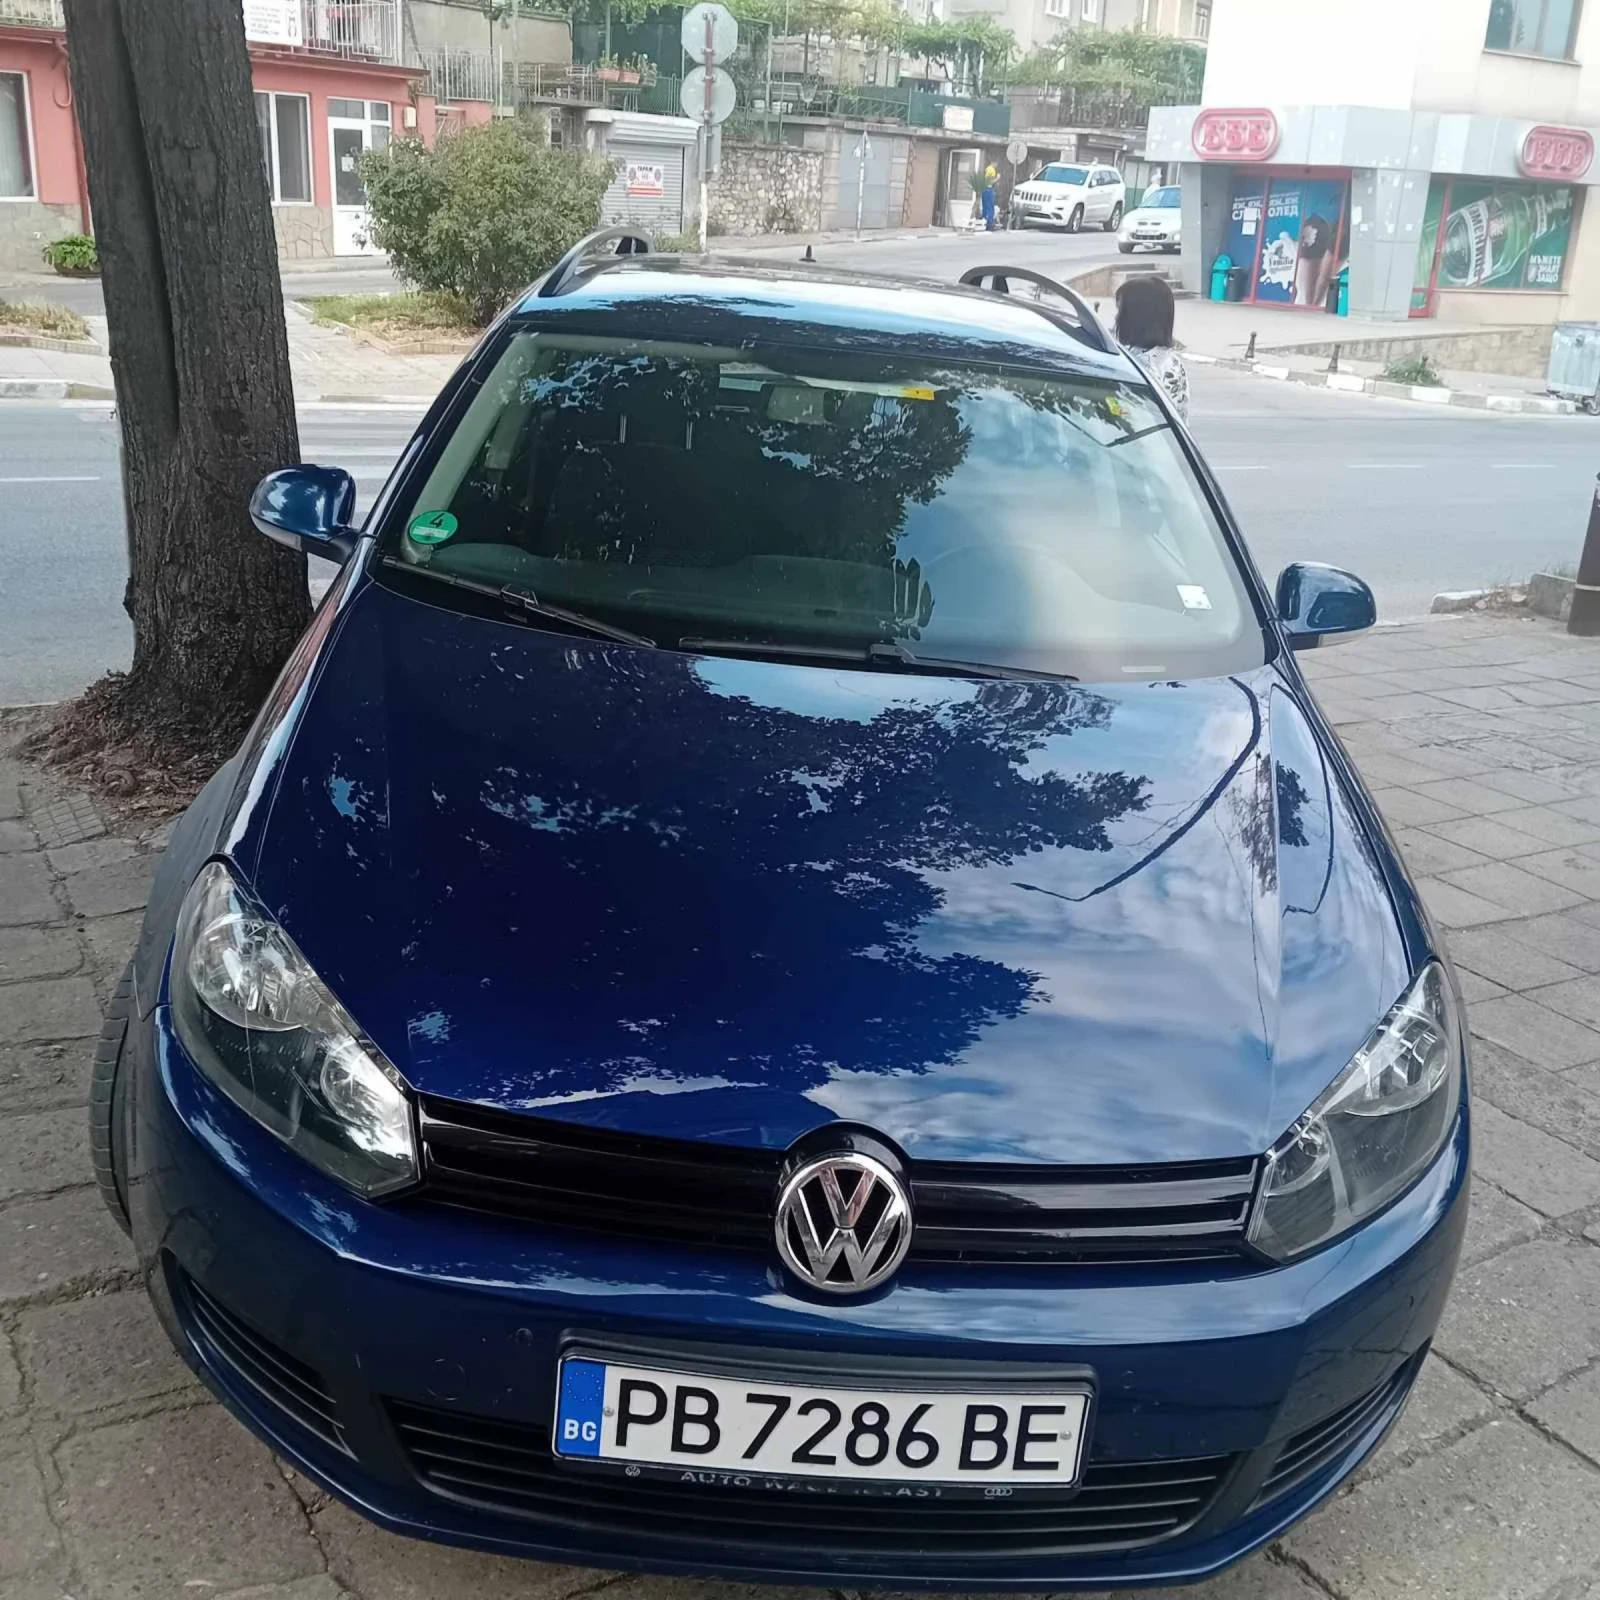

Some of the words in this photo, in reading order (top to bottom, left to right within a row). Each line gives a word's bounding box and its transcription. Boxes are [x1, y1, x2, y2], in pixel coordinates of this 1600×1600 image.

[430, 512, 446, 528] 4
[563, 1418, 597, 1442] BG
[616, 1378, 721, 1455] PB
[741, 1392, 939, 1469] 7286
[958, 1404, 1066, 1471] BE
[681, 1471, 750, 1487] AUTO
